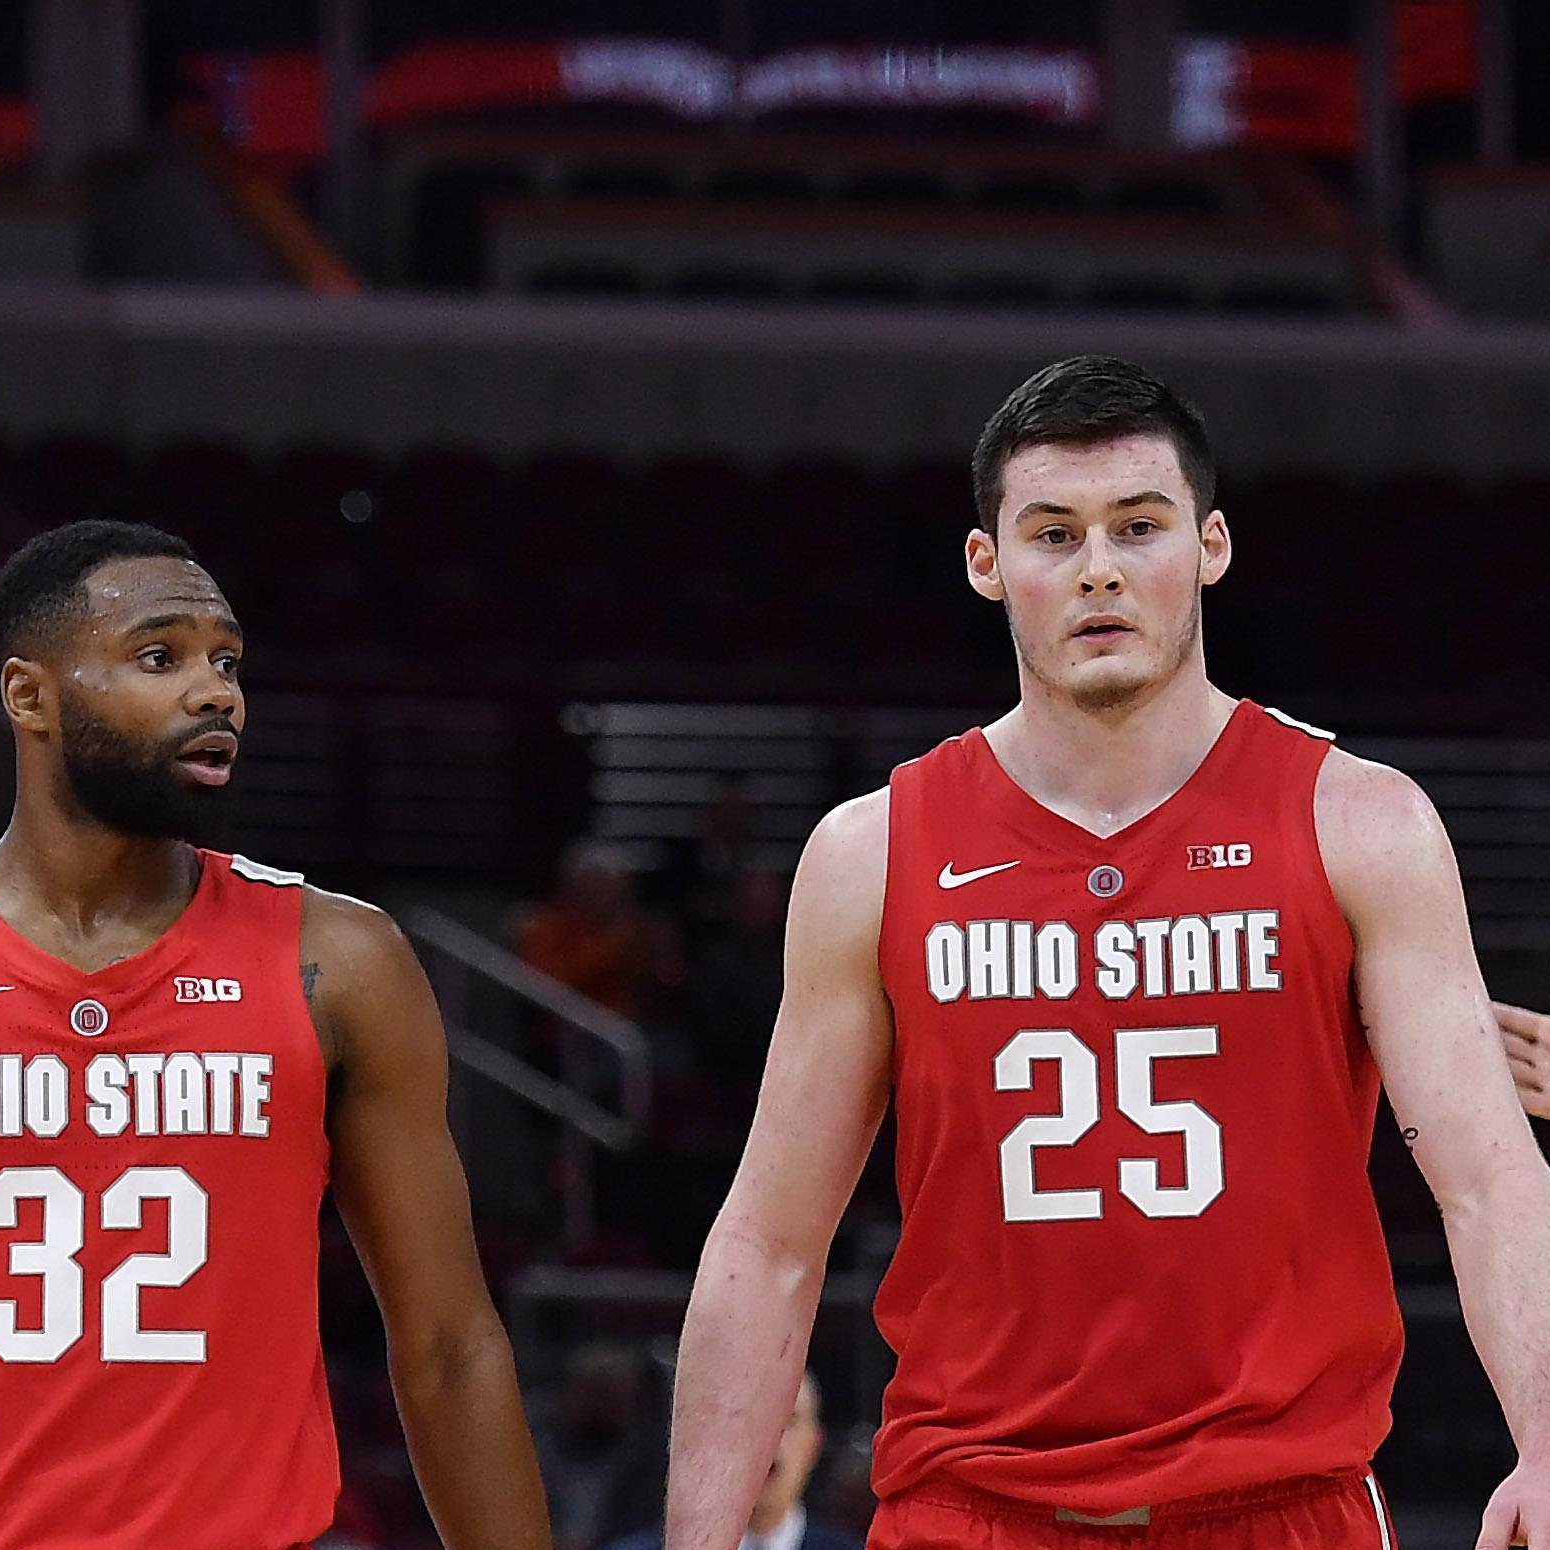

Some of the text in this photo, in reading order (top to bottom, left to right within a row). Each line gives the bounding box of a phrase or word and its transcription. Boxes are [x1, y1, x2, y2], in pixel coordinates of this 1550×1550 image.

[925, 910, 1282, 1003] OHIO STATE
[85, 1052, 273, 1137] STATE
[994, 1025, 1225, 1222] 25
